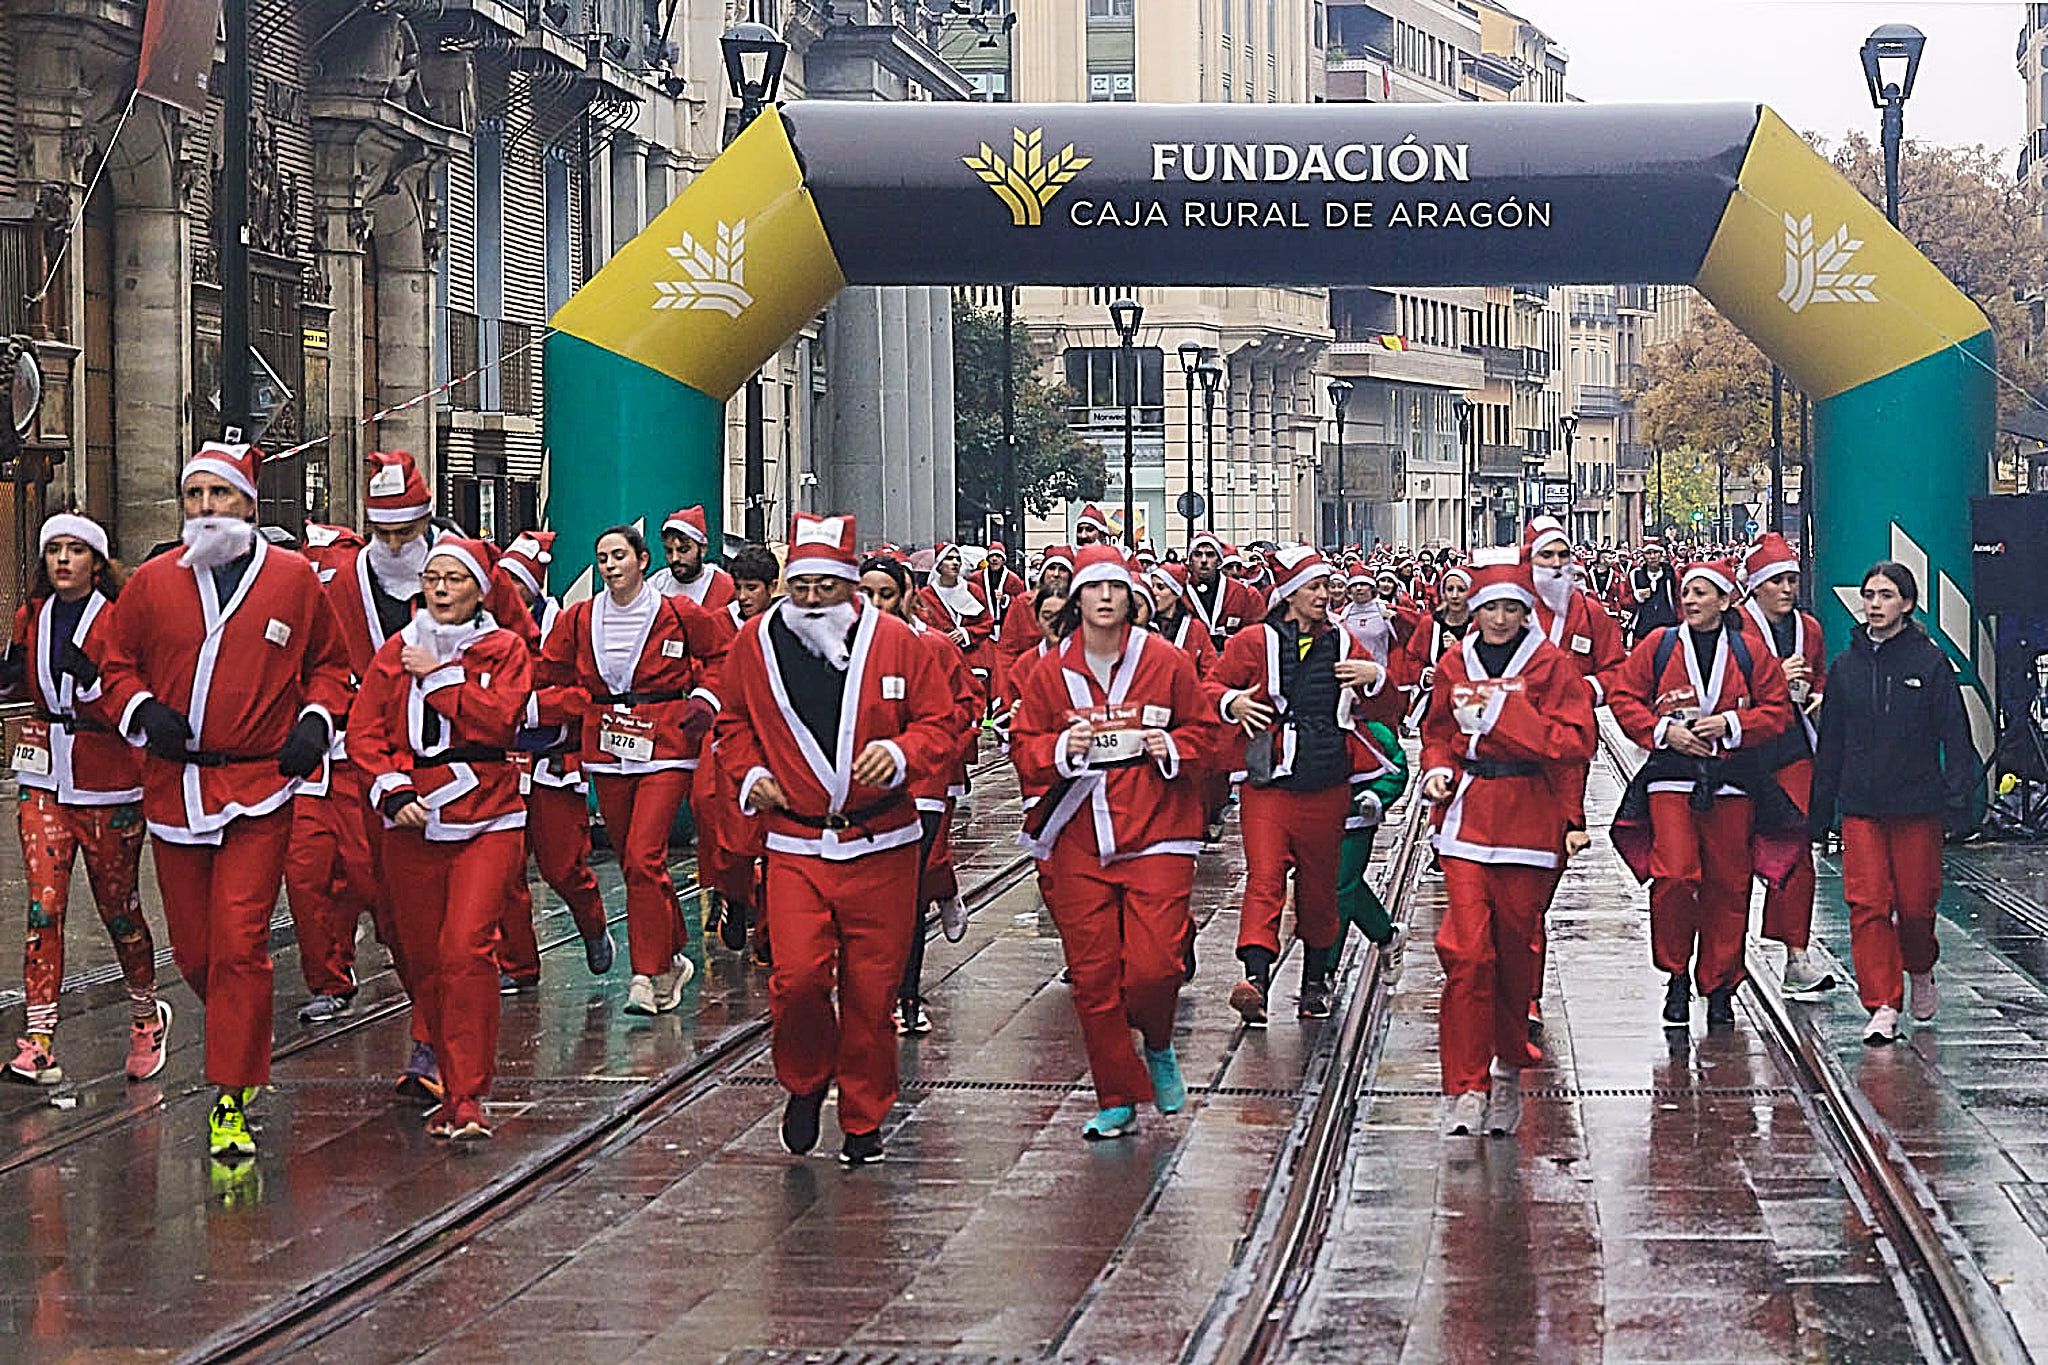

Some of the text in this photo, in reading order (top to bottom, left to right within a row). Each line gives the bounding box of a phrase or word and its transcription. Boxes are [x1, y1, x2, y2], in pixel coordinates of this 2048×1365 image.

[1152, 134, 1470, 182] FUNDACIÓN
[1070, 195, 1551, 228] CAJA RURAL DE ARAGÓN
